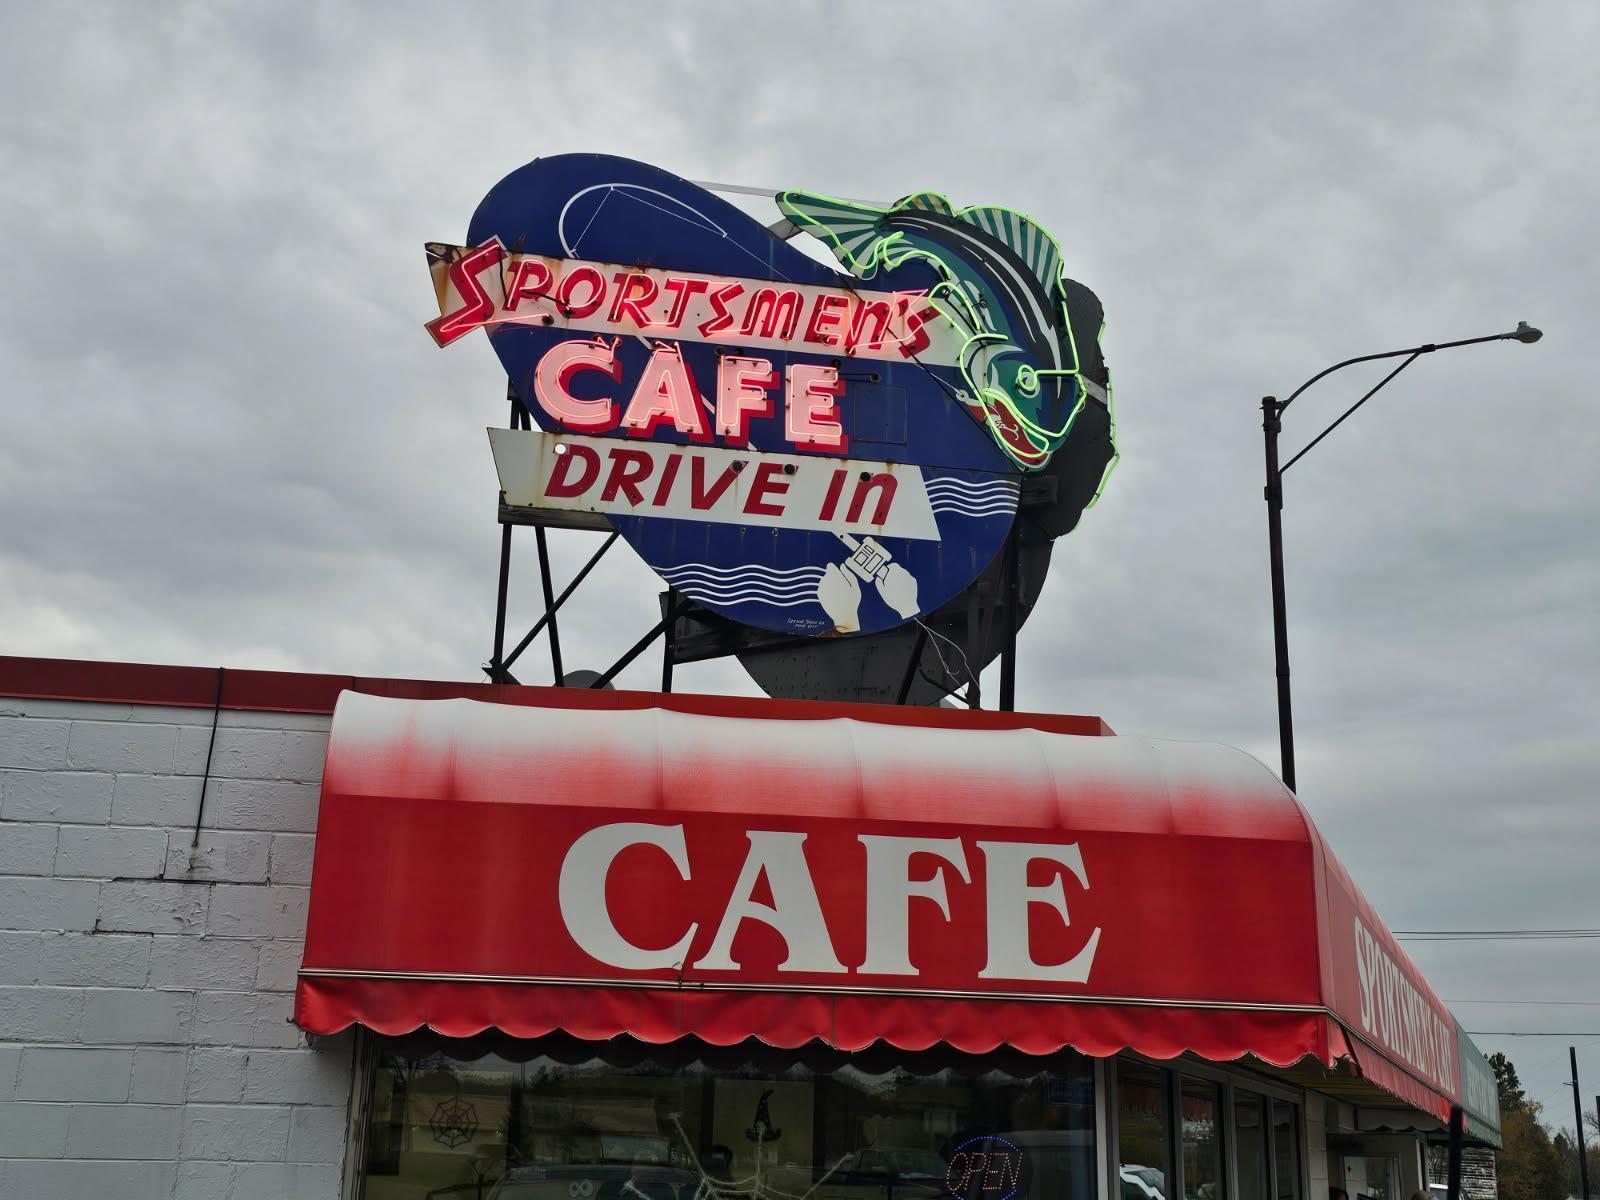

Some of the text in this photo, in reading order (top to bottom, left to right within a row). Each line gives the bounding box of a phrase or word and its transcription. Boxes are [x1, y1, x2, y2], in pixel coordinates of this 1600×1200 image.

[534, 339, 848, 454] CAFE
[544, 443, 798, 517] DRIVE
[558, 822, 1102, 984] CAFE
[946, 1152, 1023, 1191] OPEN
